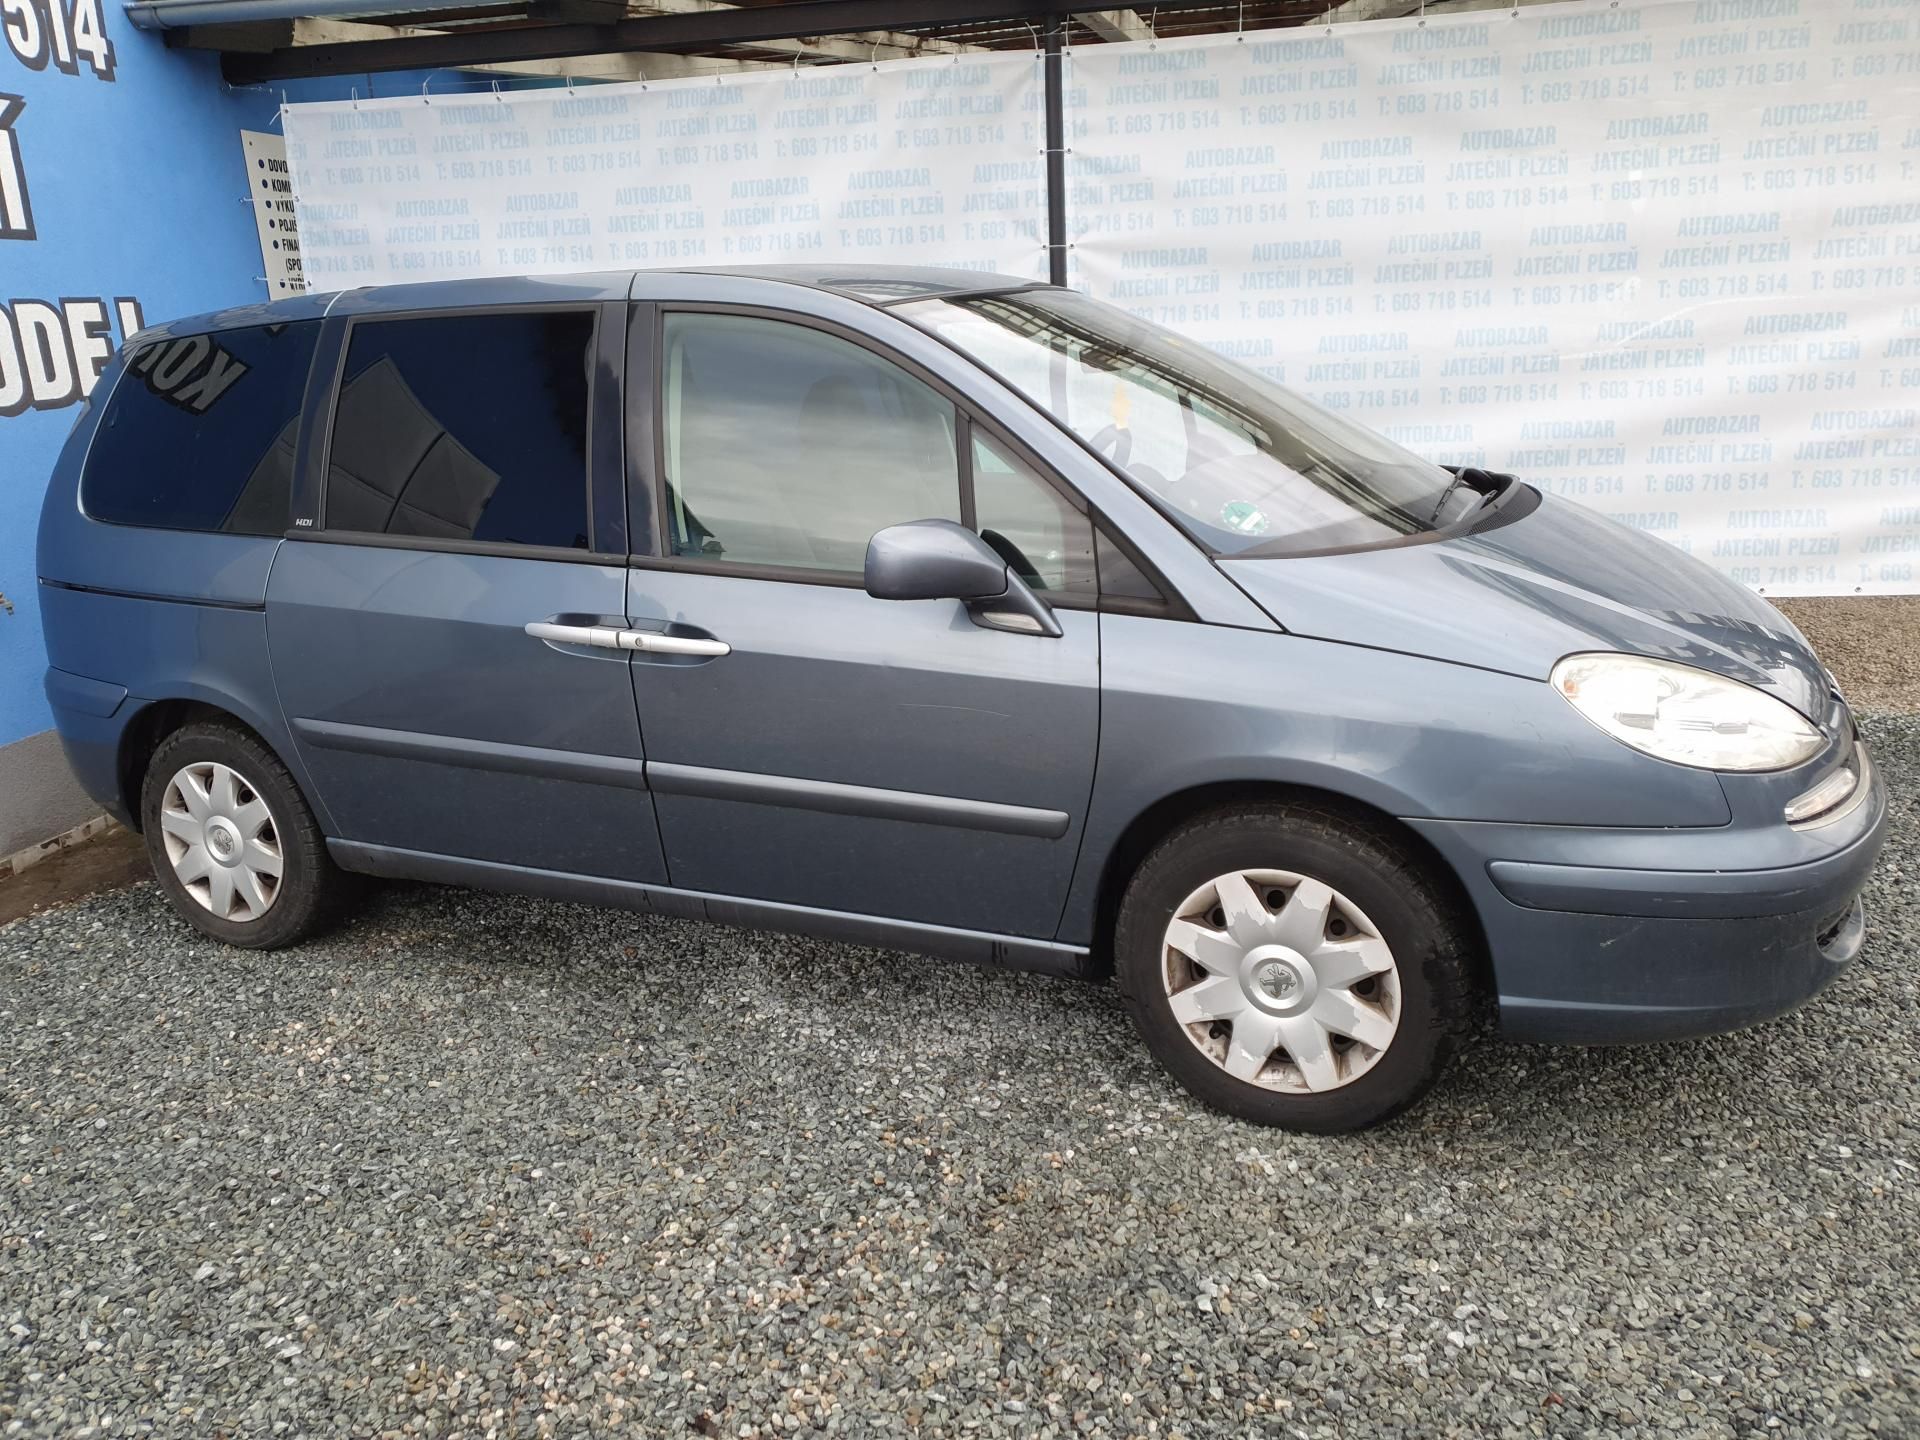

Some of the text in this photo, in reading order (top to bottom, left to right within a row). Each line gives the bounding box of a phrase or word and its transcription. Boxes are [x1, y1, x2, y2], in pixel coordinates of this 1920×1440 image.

[1538, 8, 1641, 39] AUTOBAZAR
[1252, 37, 1344, 64] AUTOBAZAR
[1392, 24, 1488, 53] AUTOBAZAR
[1118, 49, 1206, 74] AUTOBAZAR
[1522, 34, 1653, 73] JATEČNÍ PLZEŇ
[906, 65, 990, 89] AUTOBAZAR
[1239, 61, 1357, 96] JATEČNÍ PLZEŇ
[1378, 49, 1502, 85] JATEČNÍ PLZEŇ
[783, 76, 864, 99] AUTOBAZAR
[1106, 73, 1219, 105] JATEČNÍ PLZEŇ
[1541, 81, 1572, 103] 603
[1579, 77, 1611, 100] 718
[1617, 74, 1649, 97] 514
[553, 95, 628, 118] AUTOBAZAR
[1258, 104, 1286, 124] 603
[1293, 101, 1321, 122] 718
[1328, 98, 1357, 119] 514
[1397, 93, 1425, 114] 603
[1433, 90, 1462, 112] 718
[1469, 87, 1500, 109] 514
[1760, 99, 1866, 127] AUTOBAZAR
[1125, 114, 1152, 134] 603
[1158, 111, 1186, 132] 718
[1192, 108, 1220, 130] 514
[1606, 112, 1708, 140] AUTOBAZAR
[791, 137, 817, 157] 603
[822, 134, 848, 155] 718
[853, 132, 879, 152] 514
[913, 128, 939, 147] 603
[944, 125, 972, 146] 718
[977, 124, 1005, 144] 514
[1320, 136, 1412, 160] AUTOBAZAR
[1743, 124, 1880, 160] JATEČNÍ PLZEŇ
[562, 154, 586, 172] 603
[590, 152, 614, 170] 718
[618, 150, 642, 168] 514
[1185, 145, 1274, 168] AUTOBAZAR
[1591, 136, 1722, 172] JATEČNÍ PLZEŇ
[848, 168, 931, 190] AUTOBAZAR
[1172, 168, 1286, 198] JATEČNÍ PLZEŇ
[1307, 159, 1425, 190] JATEČNÍ PLZEŇ
[1611, 180, 1641, 200] 603
[1648, 177, 1680, 198] 718
[1687, 174, 1719, 195] 514
[1763, 168, 1796, 190] 603
[1804, 165, 1836, 187] 718
[1843, 162, 1876, 184] 514
[506, 192, 579, 212] AUTOBAZAR
[616, 184, 692, 205] AUTOBAZAR
[837, 190, 944, 219] JATEČNÍ PLZEŇ
[1326, 198, 1354, 217] 603
[1361, 196, 1389, 216] 718
[1396, 193, 1425, 214] 514
[1192, 206, 1219, 226] 603
[1225, 204, 1253, 224] 718
[1260, 202, 1287, 222] 514
[1676, 212, 1778, 237] AUTOBAZAR
[282, 238, 300, 252] FINA
[856, 227, 882, 246] 603
[887, 225, 914, 245] 718
[919, 224, 946, 243] 514
[1387, 230, 1480, 254] AUTOBAZAR
[513, 247, 537, 265] 603
[541, 245, 565, 264] 718
[570, 244, 594, 262] 514
[624, 241, 649, 259] 603
[653, 239, 677, 258] 718
[682, 238, 706, 256] 514
[1251, 239, 1341, 261] AUTOBAZAR
[1659, 236, 1791, 268] JATEČNÍ PLZEŇ
[1238, 261, 1353, 291] JATEČNÍ PLZEŇ
[1373, 254, 1493, 284] JATEČNÍ PLZEŇ
[1677, 277, 1710, 298] 603
[1717, 274, 1749, 296] 718
[1755, 272, 1788, 293] 514
[1258, 299, 1285, 318] 603
[1291, 297, 1319, 316] 718
[1325, 295, 1353, 314] 514
[1392, 292, 1420, 311] 603
[1427, 290, 1456, 310] 718
[1462, 288, 1491, 308] 514
[1743, 311, 1847, 335] AUTOBAZAR
[1454, 326, 1547, 347] AUTOBAZAR
[1440, 348, 1560, 376] JATEČNÍ PLZEŇ
[1727, 335, 1860, 365] JATEČNÍ PLZEŇ
[1458, 385, 1487, 404] 603
[1494, 383, 1522, 403] 718
[1529, 382, 1558, 401] 514
[1747, 374, 1778, 393] 603
[1786, 372, 1818, 392] 718
[1824, 370, 1857, 390] 514
[1662, 414, 1760, 435] AUTOBAZAR
[1646, 437, 1773, 464] JATEČNÍ PLZEŇ
[1664, 473, 1694, 492] 603
[1701, 472, 1732, 491] 718
[1738, 471, 1770, 490] 514
